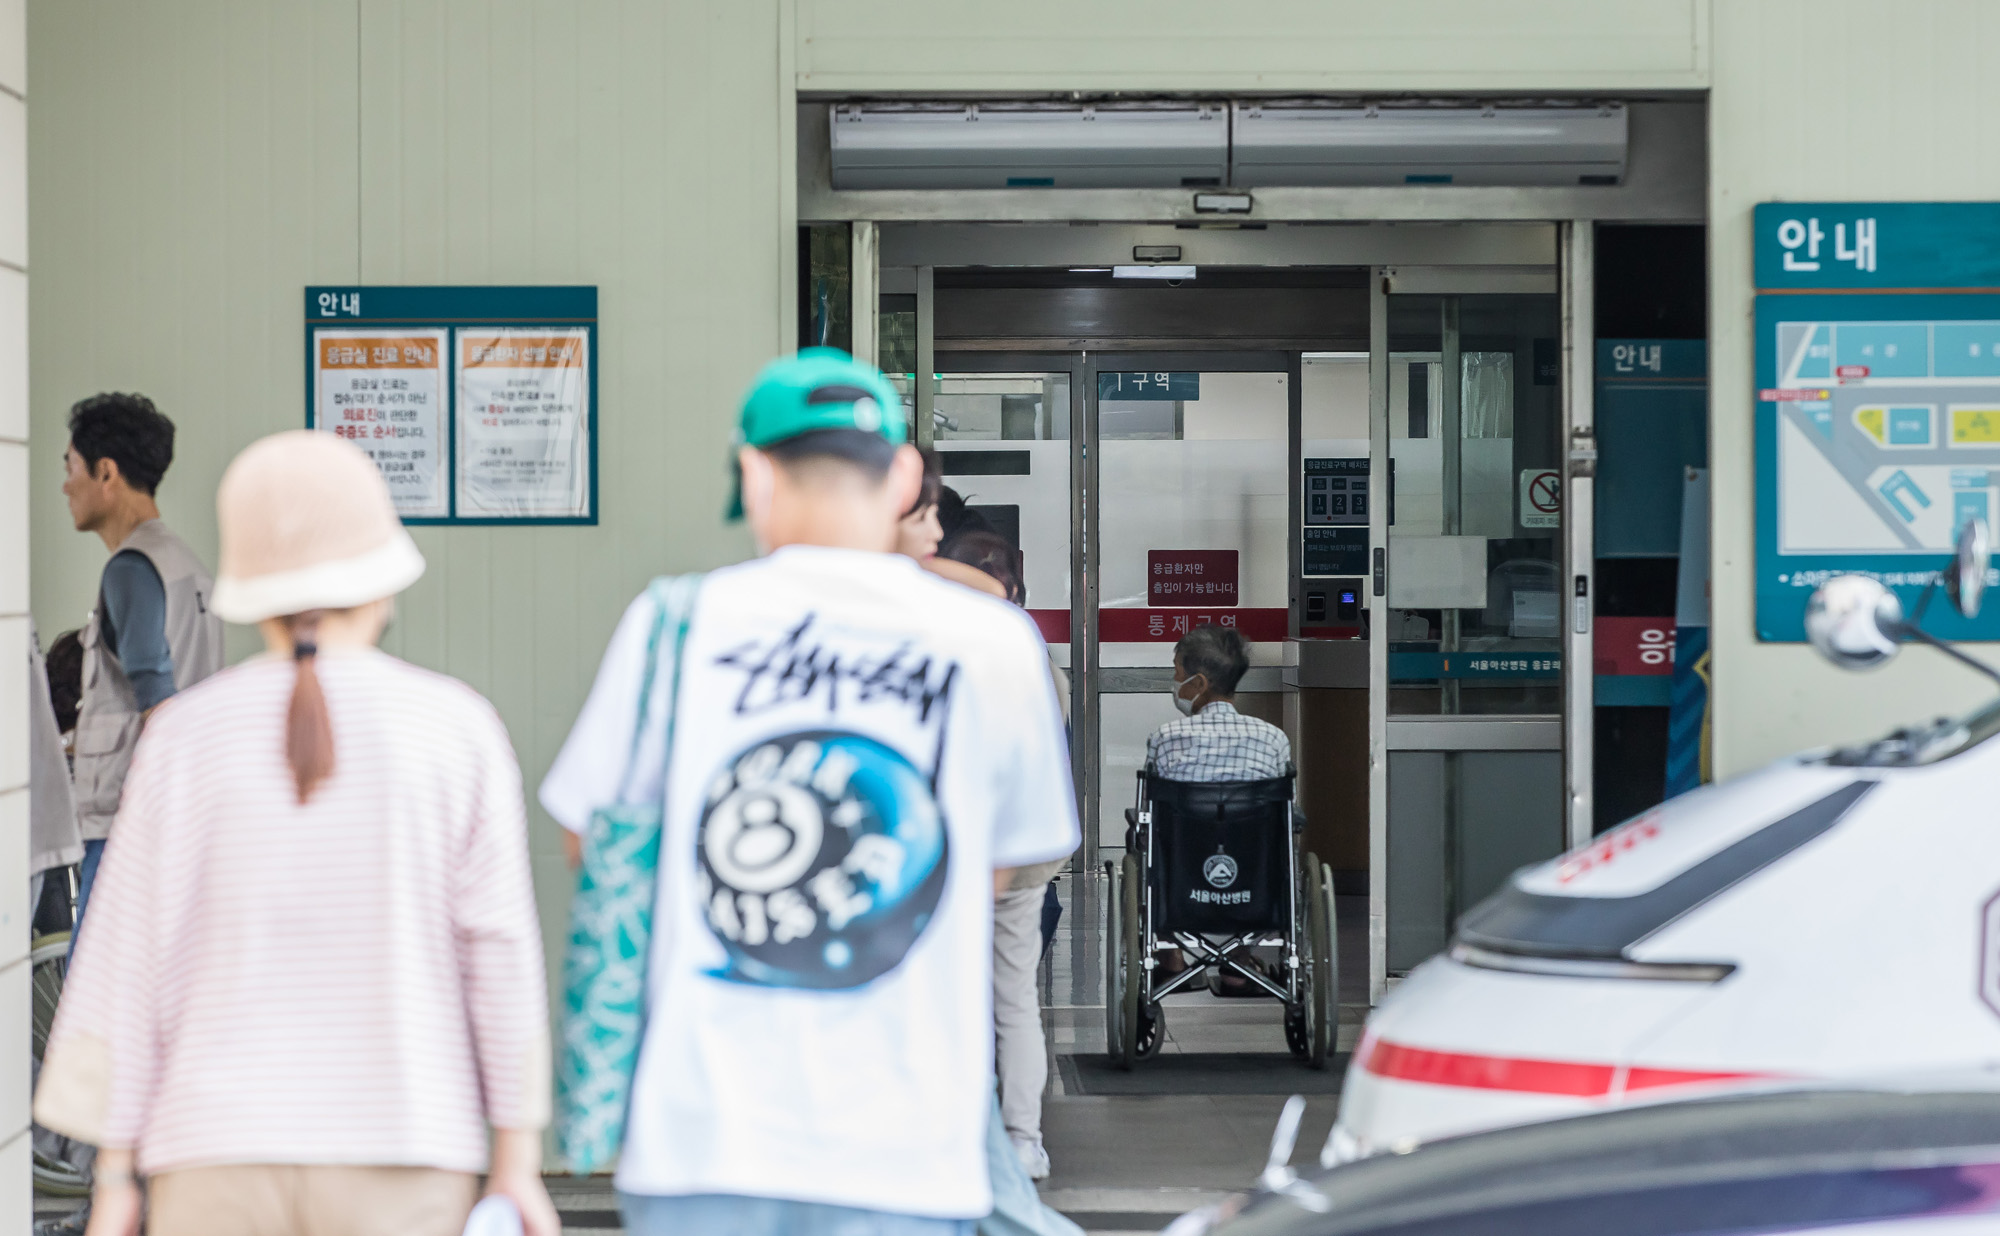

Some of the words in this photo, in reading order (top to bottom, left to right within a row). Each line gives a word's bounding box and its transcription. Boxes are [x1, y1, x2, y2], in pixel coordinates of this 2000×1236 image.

[1777, 218, 1877, 273] 안내
[318, 293, 360, 317] 안내
[327, 346, 368, 365] 응급실
[403, 346, 432, 364] 안내
[1612, 344, 1662, 372] 안내
[343, 408, 387, 422] 의료진이
[1336, 496, 1343, 506] 2
[1356, 496, 1363, 506] 3
[1322, 529, 1337, 539] 안내
[1153, 563, 1204, 576] 응급환자만
[1153, 582, 1182, 594] 출입이
[1184, 582, 1236, 594] 가능합니다.
[1469, 660, 1528, 671] 서울아산병원
[1189, 889, 1251, 905] 서울아산병원
